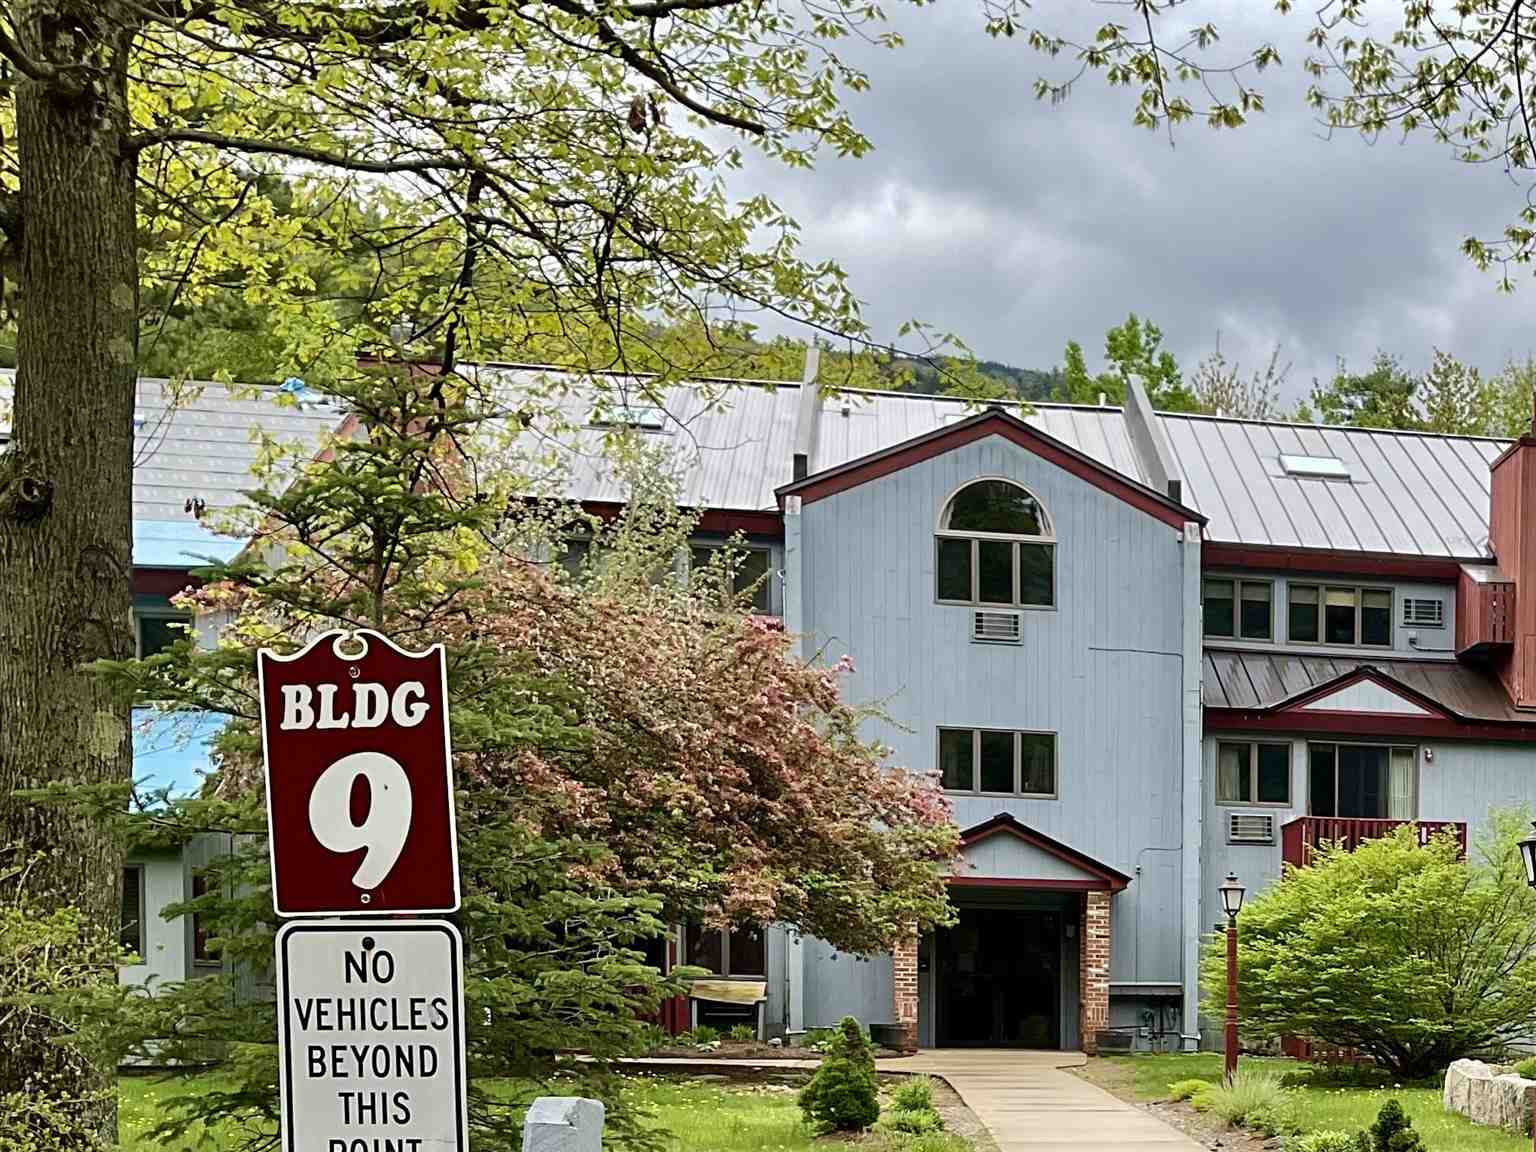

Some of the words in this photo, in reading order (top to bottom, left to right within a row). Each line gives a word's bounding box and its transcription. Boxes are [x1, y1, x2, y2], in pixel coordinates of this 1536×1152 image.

[280, 681, 430, 730] BLDG
[308, 751, 413, 890] 9
[344, 950, 394, 984] NO
[294, 997, 449, 1031] VEHICLES
[307, 1045, 438, 1078] BEYOND
[338, 1091, 411, 1125] THIS
